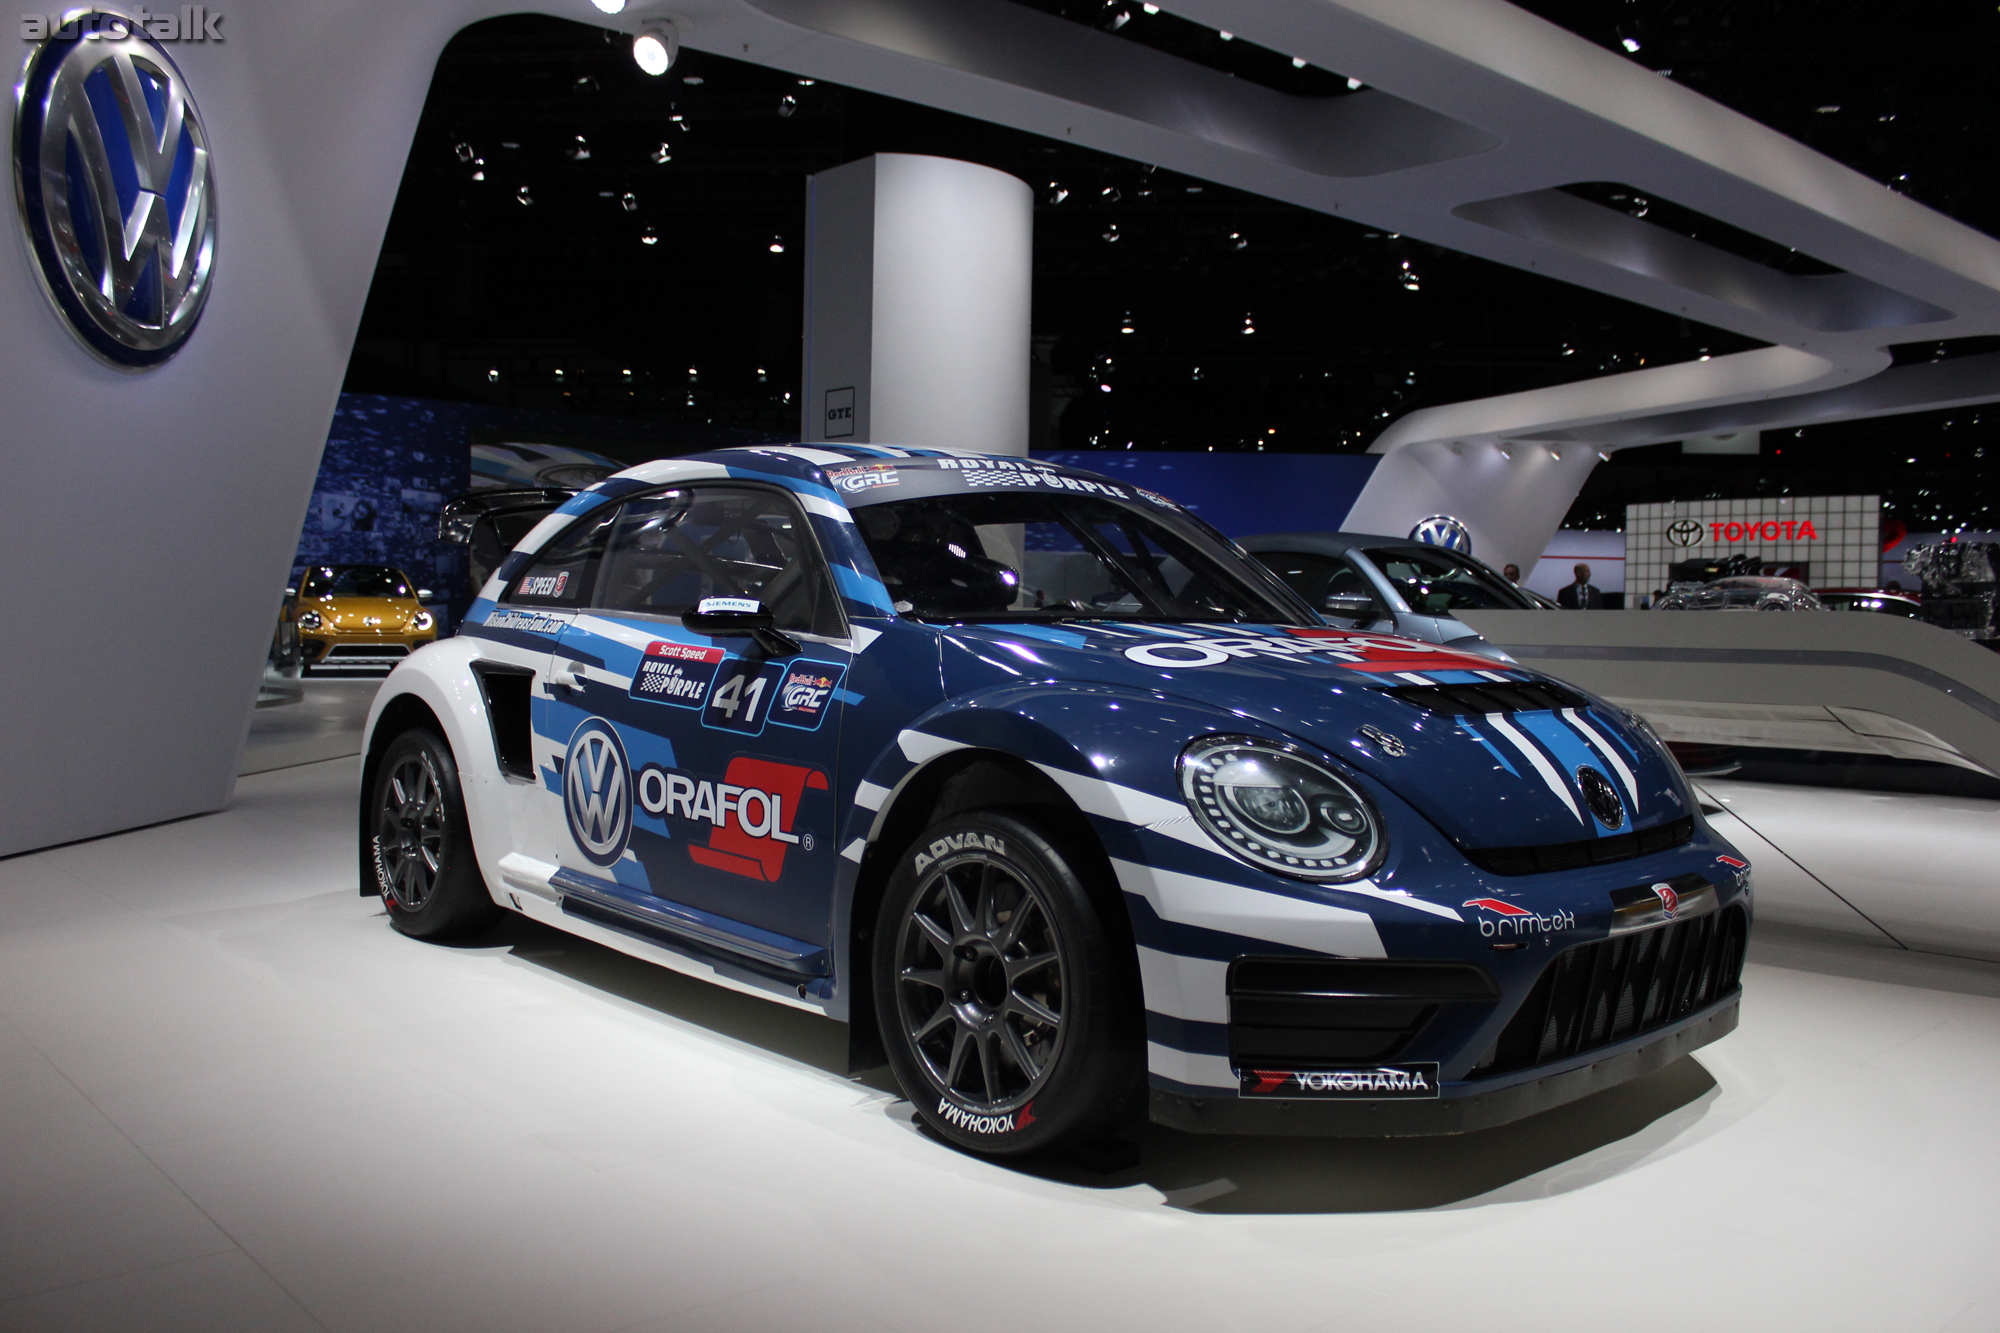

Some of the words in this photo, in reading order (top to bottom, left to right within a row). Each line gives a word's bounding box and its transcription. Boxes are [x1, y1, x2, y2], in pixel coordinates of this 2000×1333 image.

[828, 407, 852, 420] GTE
[937, 458, 1031, 471] ROYAL
[847, 471, 899, 489] GRC
[1023, 471, 1130, 499] PURPLE
[1709, 521, 1817, 542] TOYOTA
[530, 577, 557, 595] SPEED
[659, 645, 681, 657] Scott
[680, 648, 708, 660] Speed
[1124, 637, 1478, 668] ORAFOL
[642, 661, 675, 675] ROYAL
[659, 676, 706, 699] PURPLE
[711, 674, 767, 722] 41
[788, 687, 829, 707] GRC
[639, 769, 799, 844] ORAFOL
[914, 832, 1006, 877] ADVAN
[372, 835, 391, 900] YOKOHAMA
[1478, 908, 1575, 937] brimtek
[1294, 1071, 1430, 1091] YOKOHAMA
[937, 1097, 1015, 1134] YOKOHAMA
